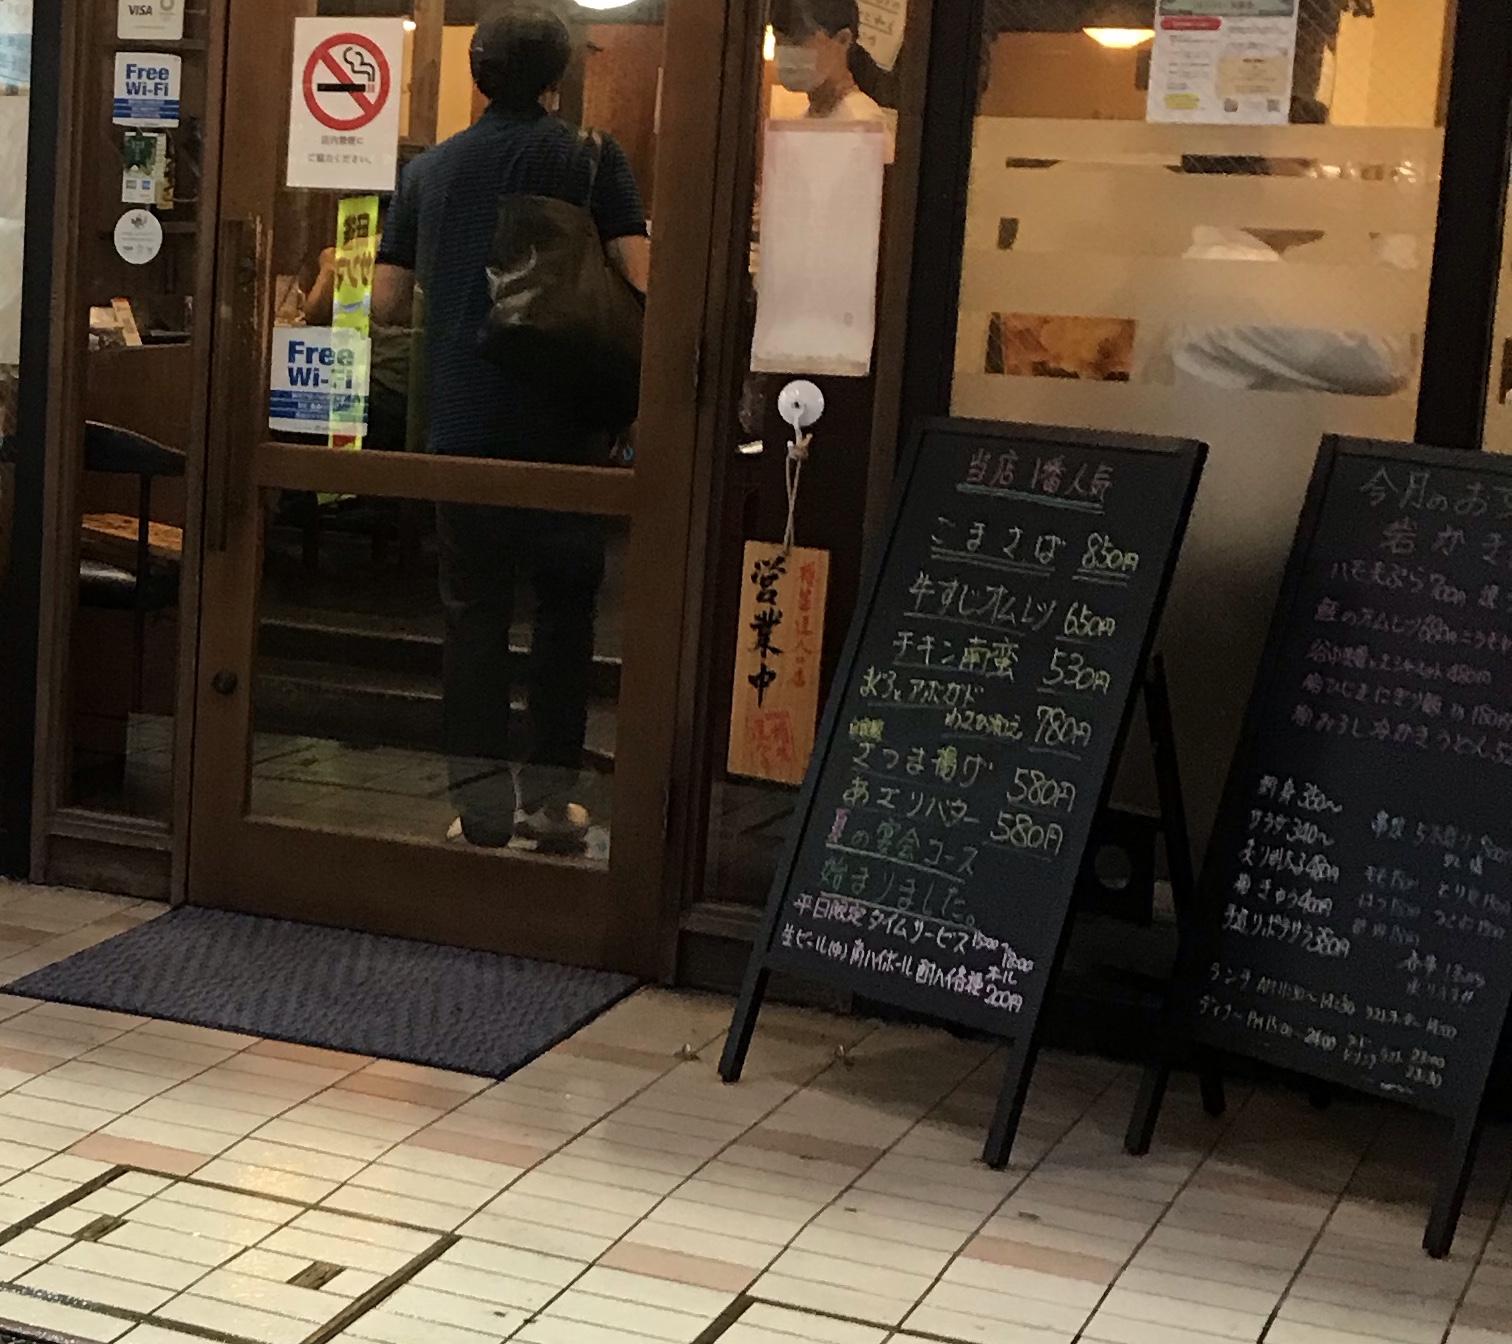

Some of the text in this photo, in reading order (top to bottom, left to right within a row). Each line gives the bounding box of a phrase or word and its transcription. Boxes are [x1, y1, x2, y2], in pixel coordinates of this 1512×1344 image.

[128, 4, 153, 17] VISA
[125, 63, 170, 81] Free
[125, 81, 169, 97] Wi-Fi
[287, 339, 355, 366] Free
[1081, 531, 1140, 572] 850円
[748, 554, 788, 709] 営業中
[1042, 646, 1112, 696] 530円
[1036, 705, 1093, 748] 780円
[1006, 765, 1078, 812] 580円
[989, 810, 1065, 856] 580円
[867, 908, 969, 955] タイムサービス
